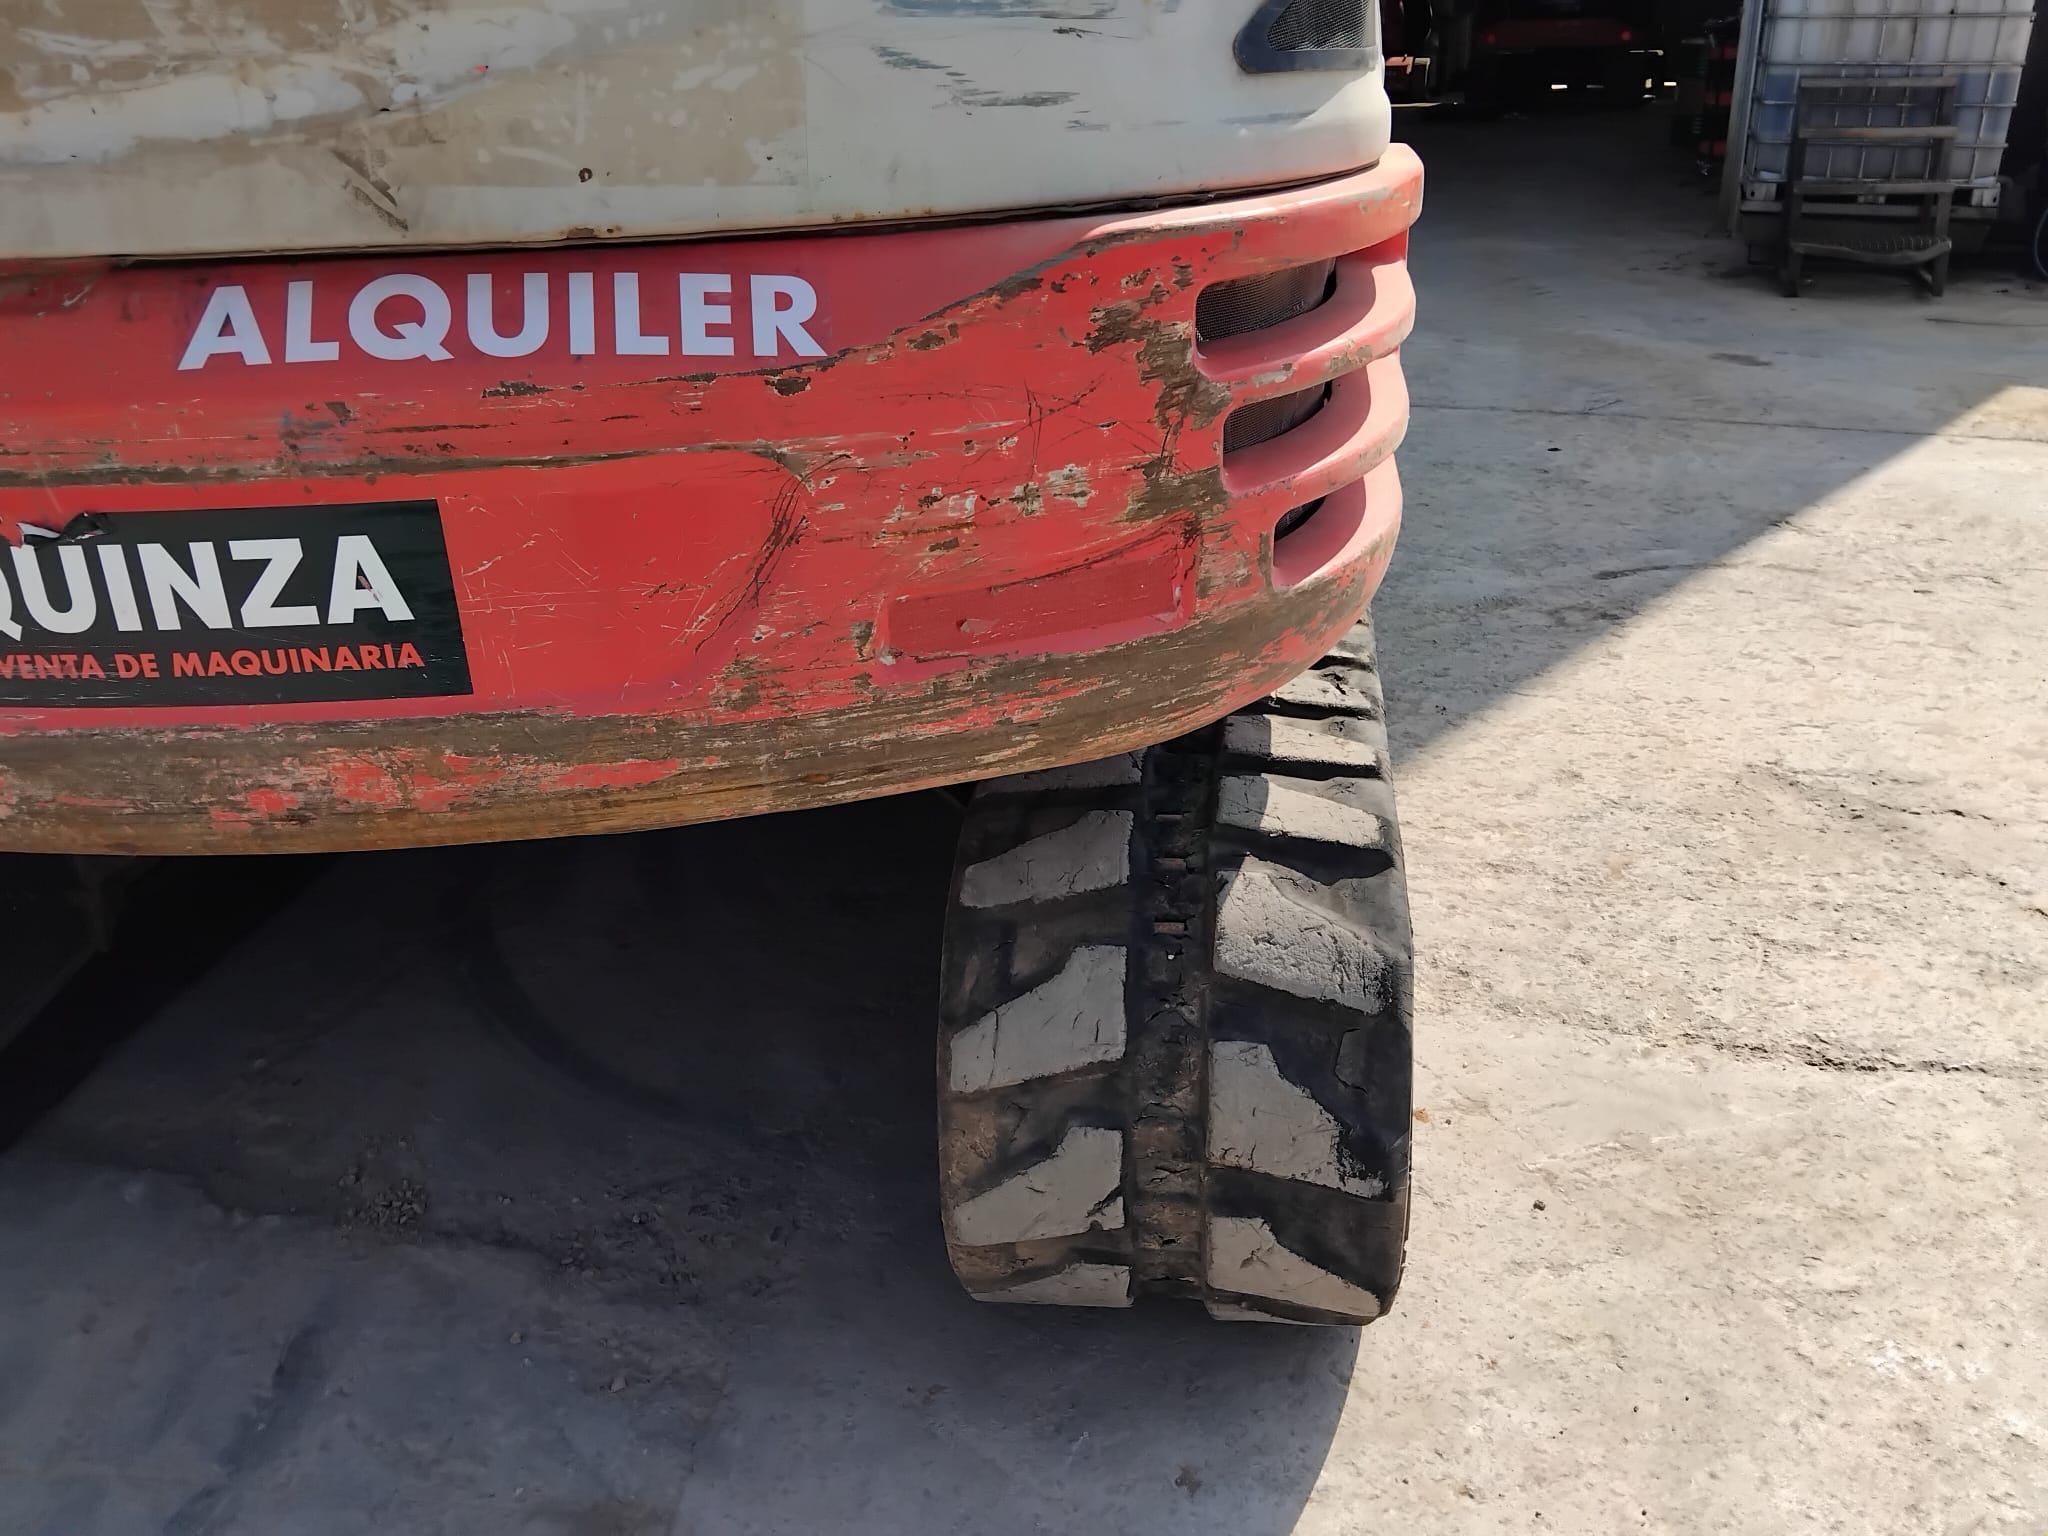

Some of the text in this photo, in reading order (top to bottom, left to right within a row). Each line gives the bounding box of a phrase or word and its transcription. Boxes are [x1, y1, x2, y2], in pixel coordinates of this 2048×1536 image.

[178, 272, 829, 371] ALQUILER
[0, 534, 415, 642] UINZA
[114, 652, 161, 679] DE
[172, 642, 425, 678] MAQUINARIA
